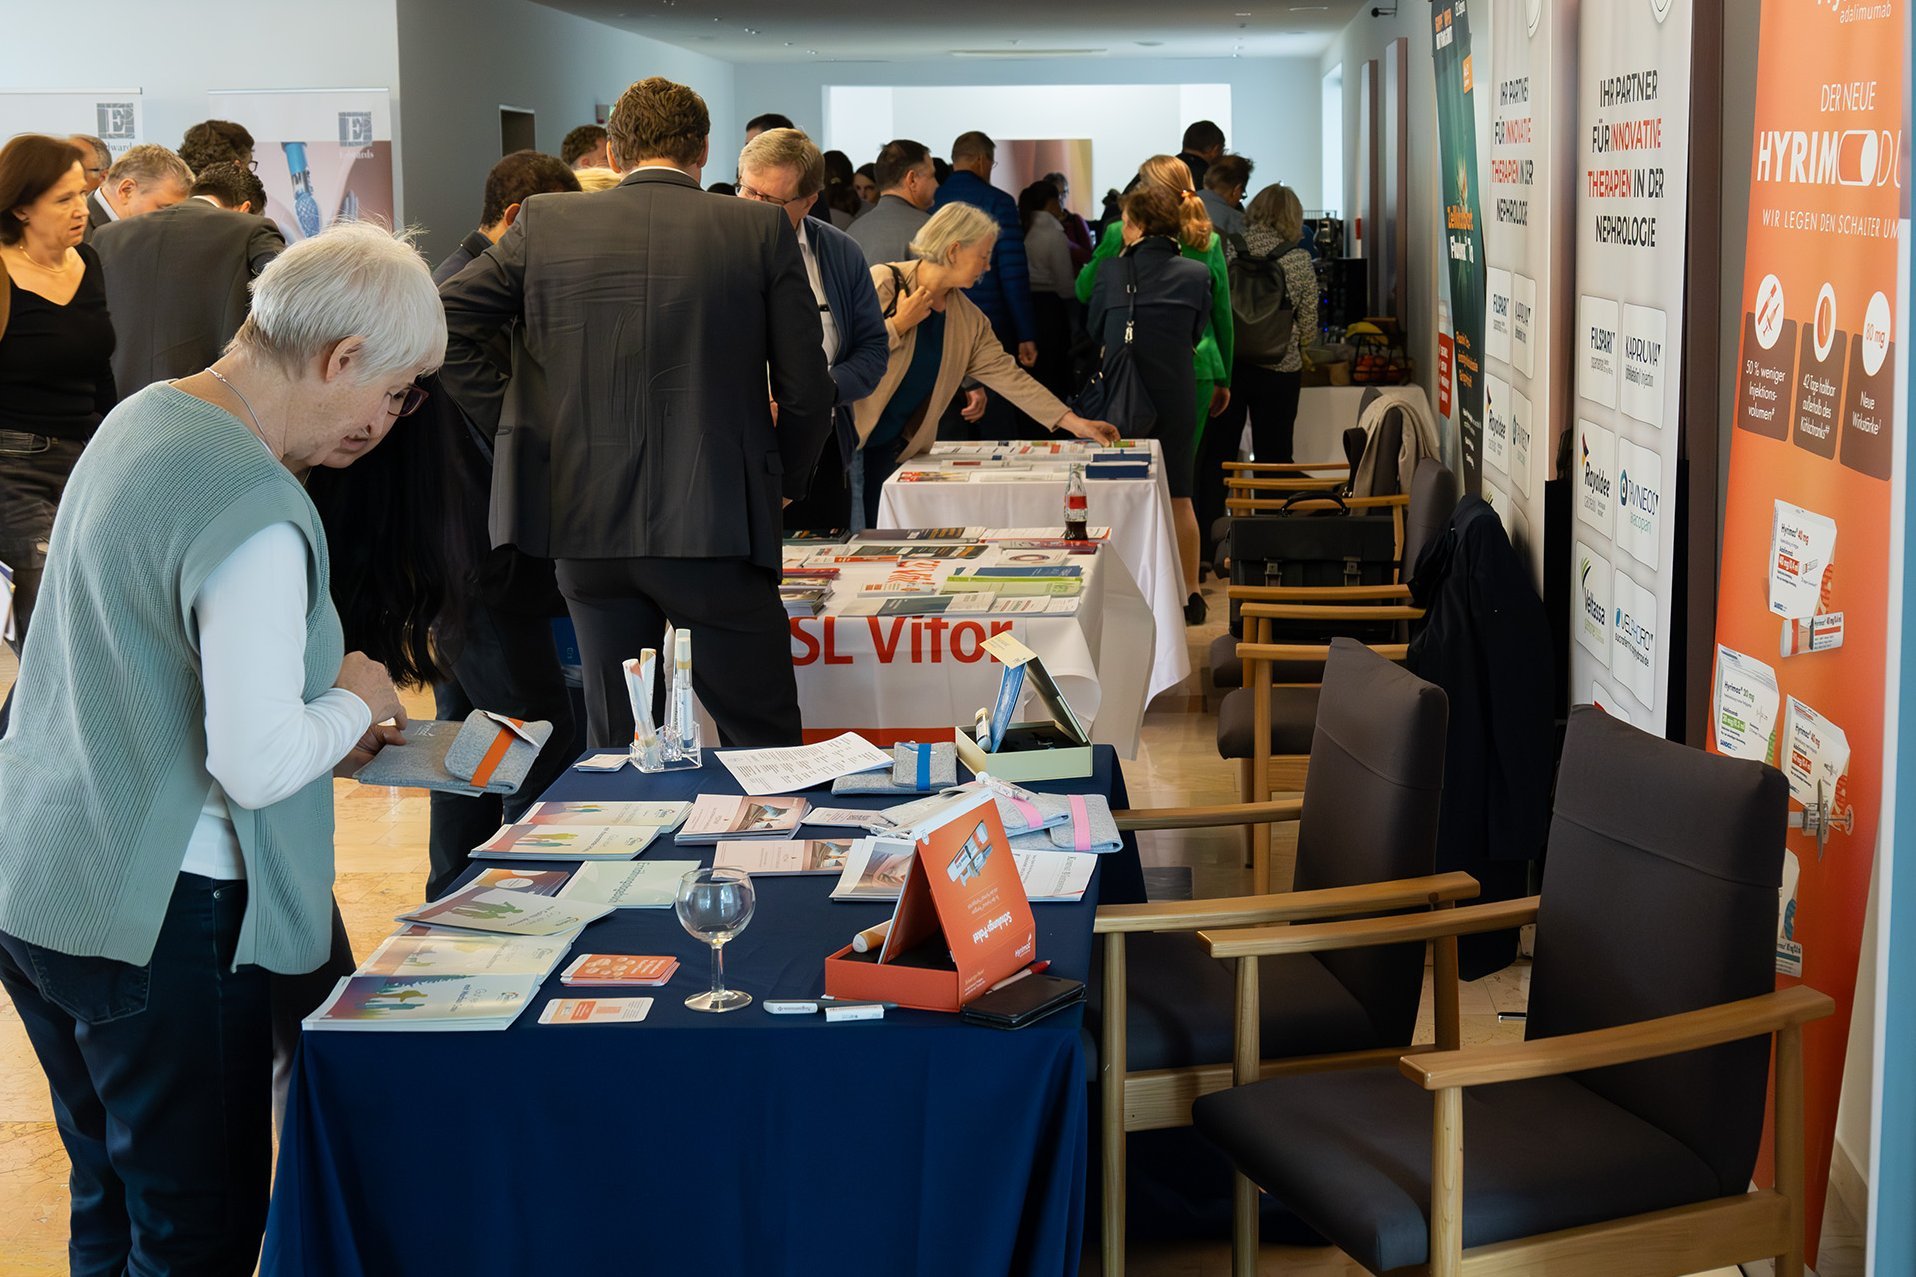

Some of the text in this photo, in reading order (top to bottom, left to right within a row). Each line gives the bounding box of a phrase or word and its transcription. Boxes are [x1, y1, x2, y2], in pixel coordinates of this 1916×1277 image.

[1839, 4, 1892, 23] adalimumab
[1600, 70, 1658, 107] IHR PARTNER
[1821, 82, 1877, 112] DER NEUE
[1592, 118, 1662, 153] FÜR INNOVATIVE
[1588, 168, 1664, 198] THERAPIEN IN DER
[1596, 215, 1656, 247] NEPHROLOGIE
[1762, 209, 1781, 227] WIR
[1784, 211, 1817, 230] LEGEN
[1820, 214, 1835, 232] DEN
[1838, 215, 1880, 237] SCHALTER
[1875, 329, 1885, 348] mg
[1745, 359, 1754, 374] 50
[1761, 367, 1786, 384] weniger
[1749, 381, 1777, 401] Injektions-
[1860, 391, 1875, 409] Neue
